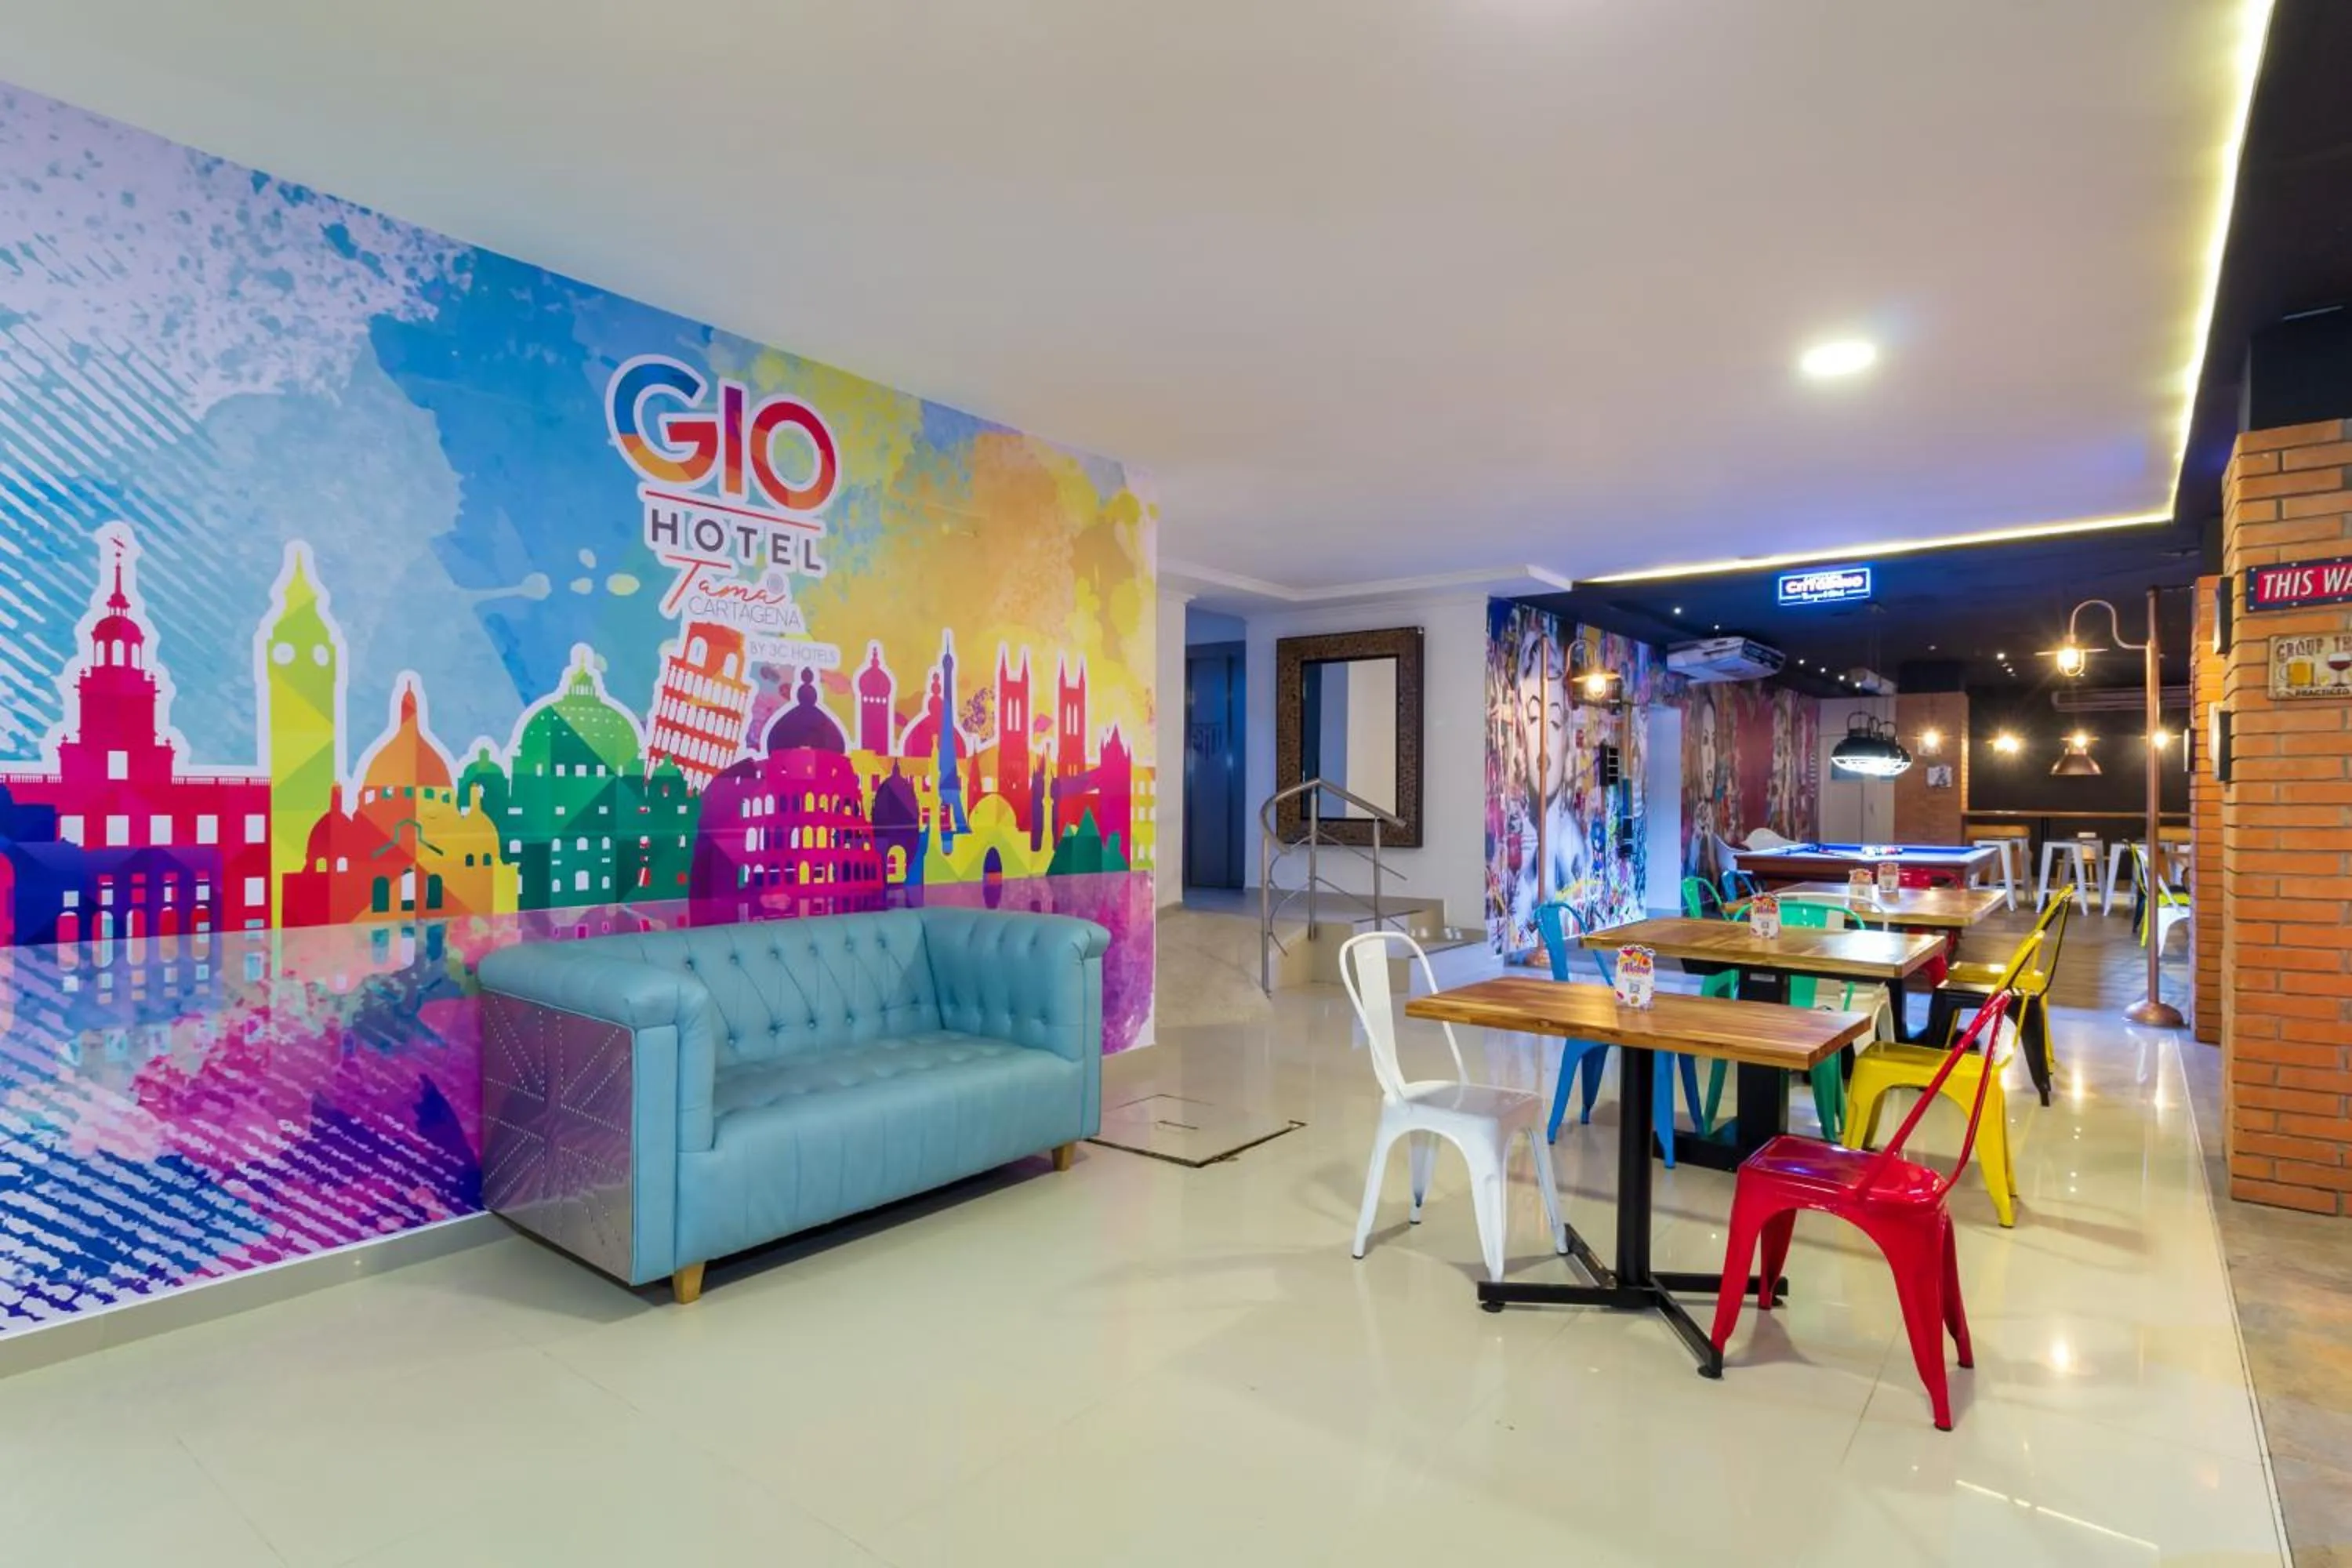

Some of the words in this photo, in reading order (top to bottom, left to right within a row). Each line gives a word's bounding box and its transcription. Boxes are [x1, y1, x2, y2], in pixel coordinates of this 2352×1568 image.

[615, 363, 836, 510] GIO
[652, 509, 822, 571] HOTEL
[665, 554, 786, 611] Tama
[688, 595, 801, 627] CARTAGENA
[2263, 570, 2314, 600] THIS
